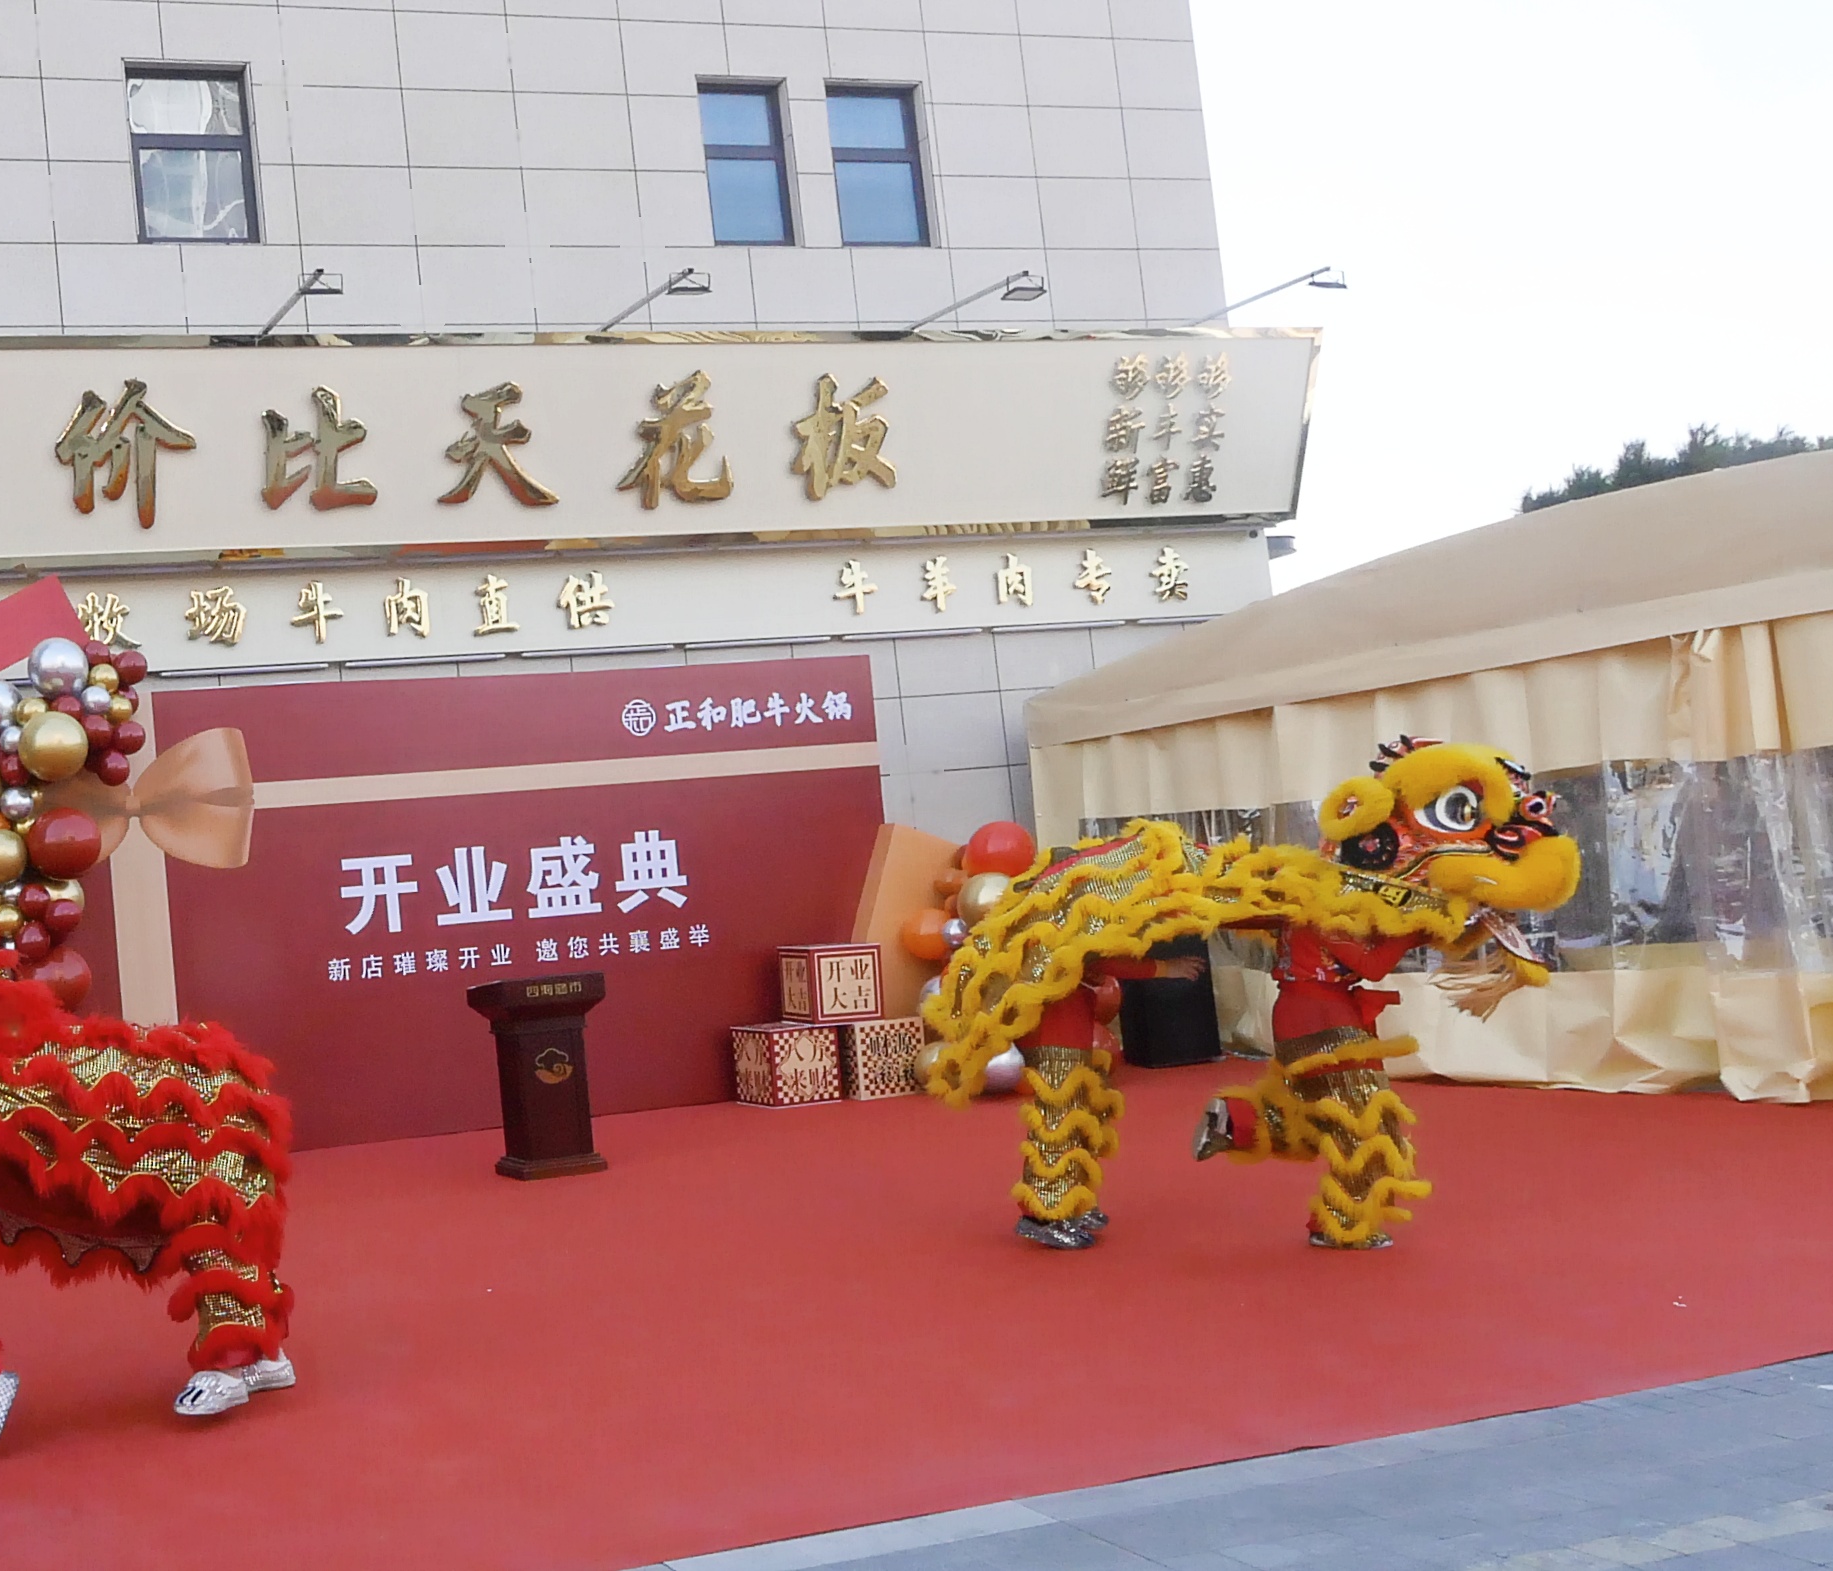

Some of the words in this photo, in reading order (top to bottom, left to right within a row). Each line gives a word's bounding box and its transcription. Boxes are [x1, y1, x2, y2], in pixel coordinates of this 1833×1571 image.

[834, 546, 1189, 615] 牛羊肉专卖
[78, 571, 615, 648] 牧场牛肉直供
[664, 690, 852, 732] 正和肥牛火锅
[340, 829, 688, 935] 开业盛典
[535, 923, 711, 962] 邀您共襄盛举
[327, 943, 513, 982] 新店璀璨开业
[785, 961, 807, 982] 开业
[825, 958, 871, 982] 开业
[827, 985, 871, 1010] 大吉
[784, 1038, 828, 1062] 八方
[869, 1033, 914, 1058] 财源
[788, 1066, 829, 1091] 来财
